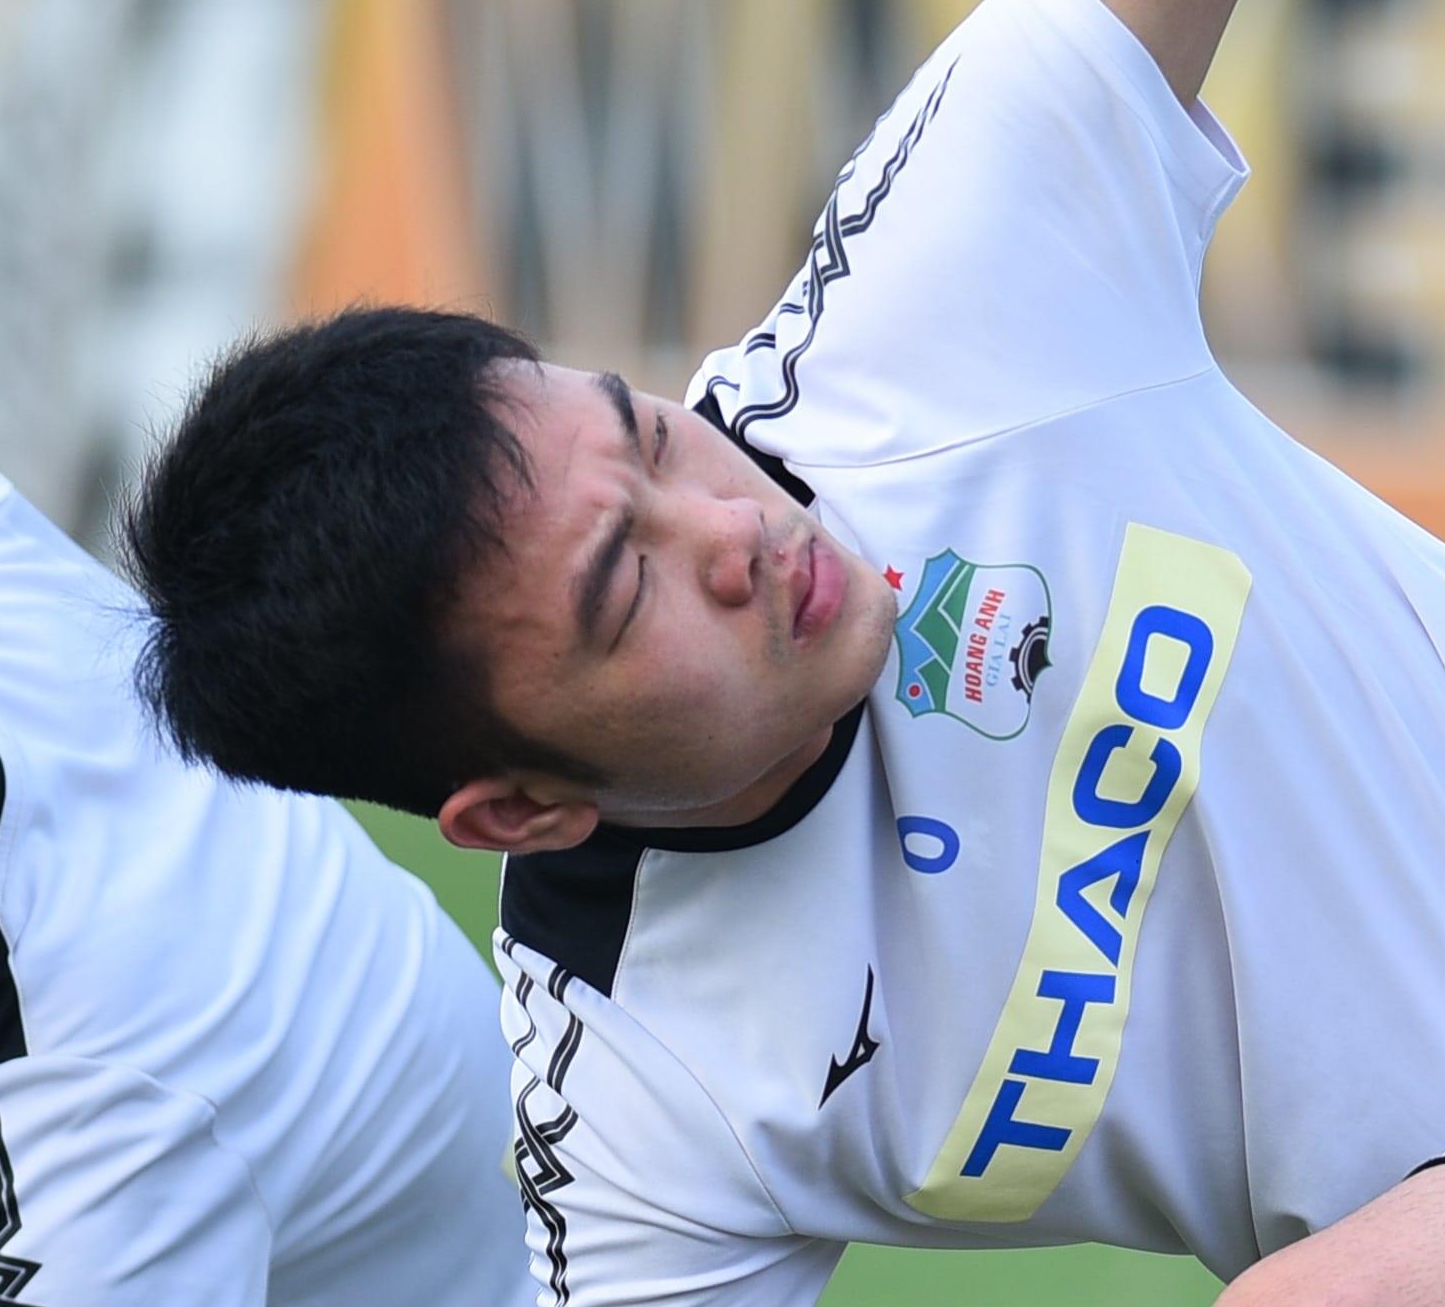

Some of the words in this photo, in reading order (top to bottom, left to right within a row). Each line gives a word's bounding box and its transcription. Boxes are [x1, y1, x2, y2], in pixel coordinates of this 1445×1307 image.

[974, 588, 1006, 632] ANH
[994, 613, 1012, 650] LAI
[964, 632, 988, 704] HOANG
[986, 649, 1004, 687] GIA
[959, 604, 1214, 1178] THACO
